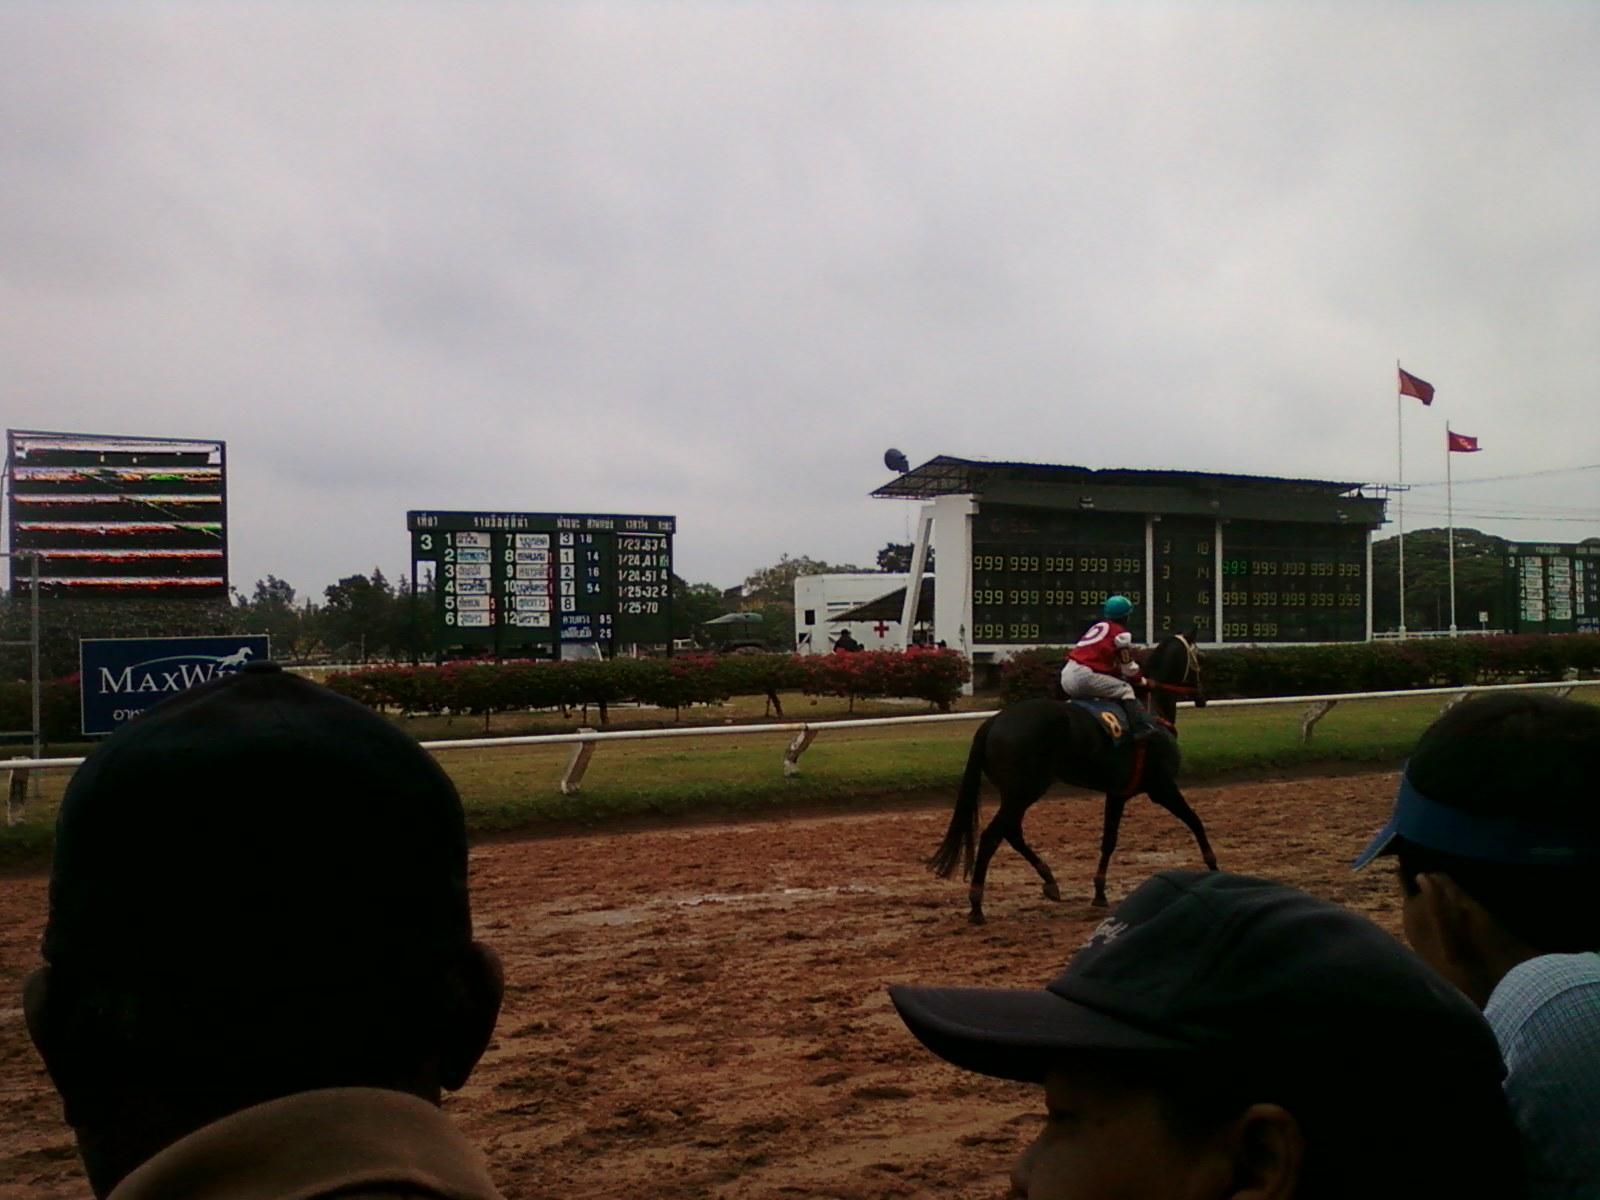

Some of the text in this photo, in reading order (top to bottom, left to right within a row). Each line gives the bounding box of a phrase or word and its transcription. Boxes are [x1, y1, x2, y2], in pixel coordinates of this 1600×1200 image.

[420, 534, 433, 551] 3
[445, 533, 452, 546] 1
[505, 534, 513, 546] 7
[562, 533, 570, 544] 3
[444, 548, 455, 562] 2
[504, 549, 514, 561] 8
[564, 551, 569, 562] 1
[444, 564, 455, 577] 3
[506, 565, 514, 577] 9
[974, 556, 1141, 573] 999 999 999 999 999
[564, 567, 570, 577] 2
[660, 569, 668, 580] 4
[444, 580, 455, 593] 4
[504, 580, 517, 593] 10
[565, 583, 571, 594] 7
[661, 585, 668, 597] 2
[444, 596, 455, 609] 5
[504, 596, 516, 608] 11
[564, 598, 572, 609] 8
[974, 590, 1004, 604] 999
[1009, 590, 1039, 605] 999
[1045, 590, 1074, 605] 999
[1080, 591, 1108, 605] 999
[444, 612, 455, 625] 6
[504, 612, 518, 624] 12
[974, 624, 1040, 639] 999 999
[1222, 623, 1278, 637] 999 999
[1101, 711, 1122, 738] 8
